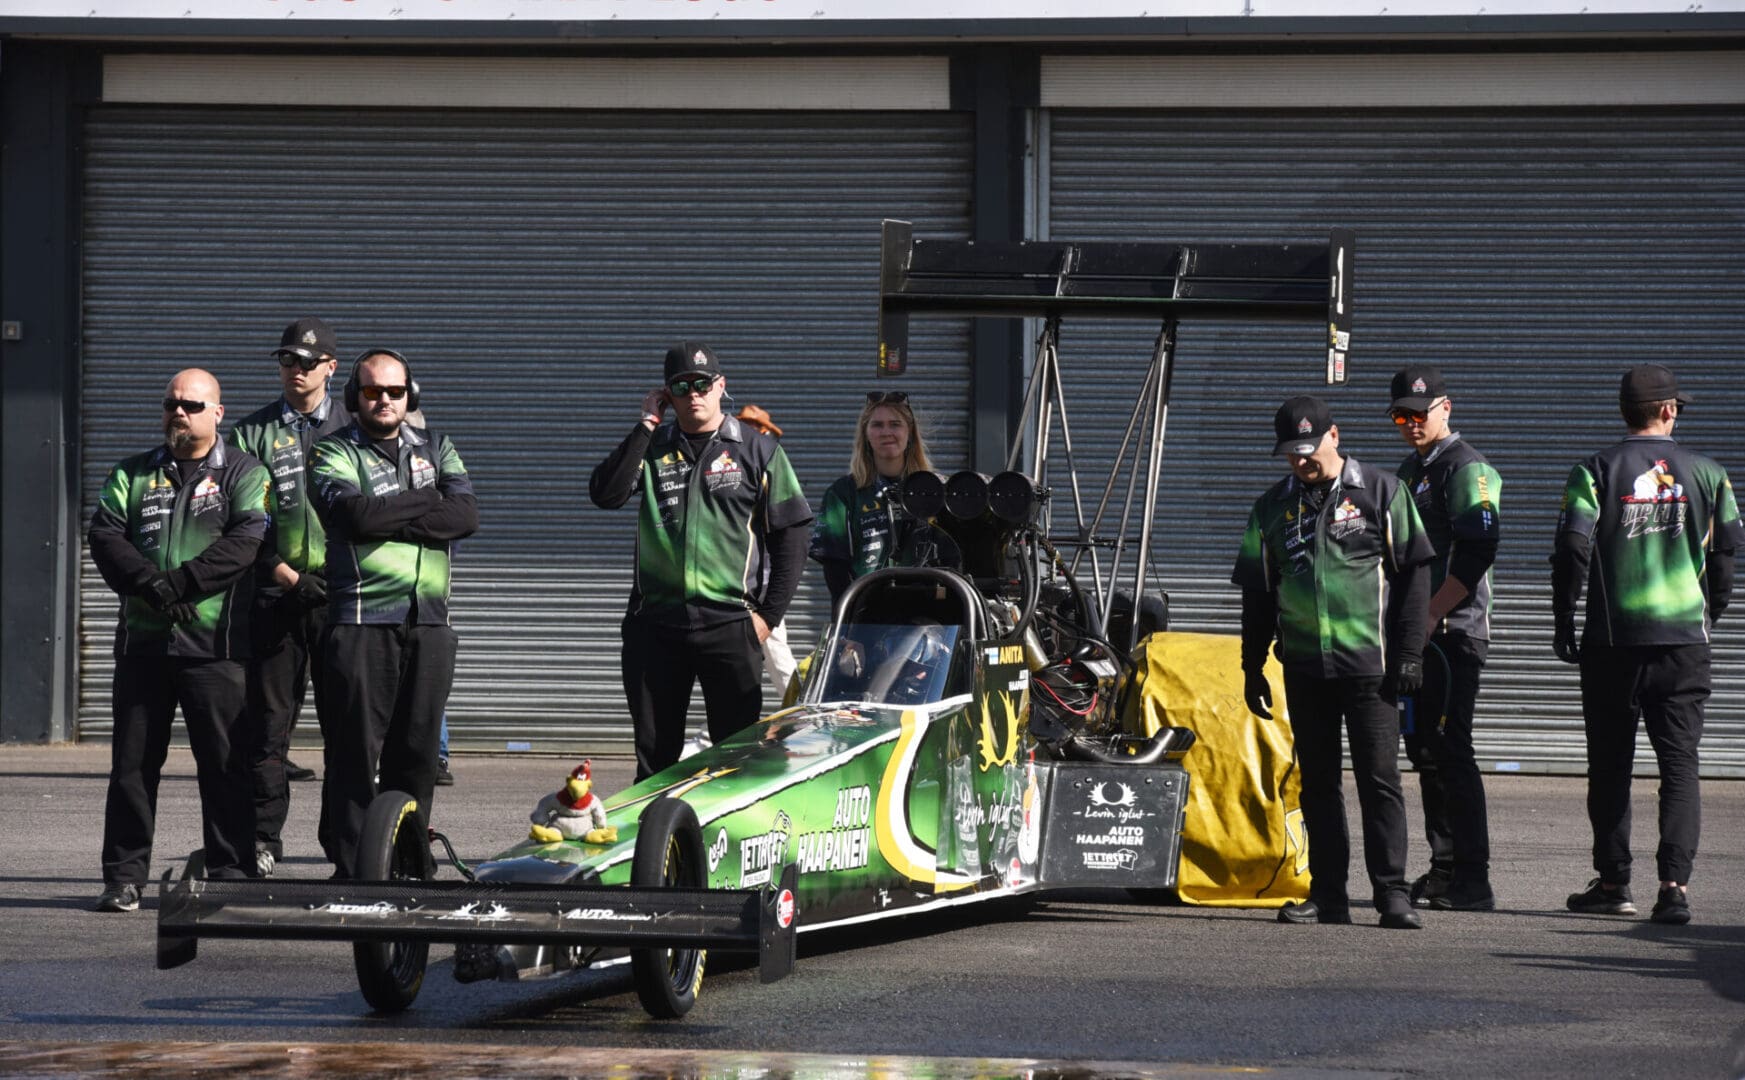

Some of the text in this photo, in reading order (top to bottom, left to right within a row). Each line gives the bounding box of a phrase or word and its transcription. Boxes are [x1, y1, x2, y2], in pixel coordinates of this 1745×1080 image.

[999, 645, 1024, 665] ANITA
[832, 785, 871, 828] AUTO
[1084, 805, 1145, 824] Levin iglut
[1076, 834, 1144, 845] HAAPANEN
[1108, 826, 1144, 836] AUTO
[796, 827, 870, 874] HAAPANEN
